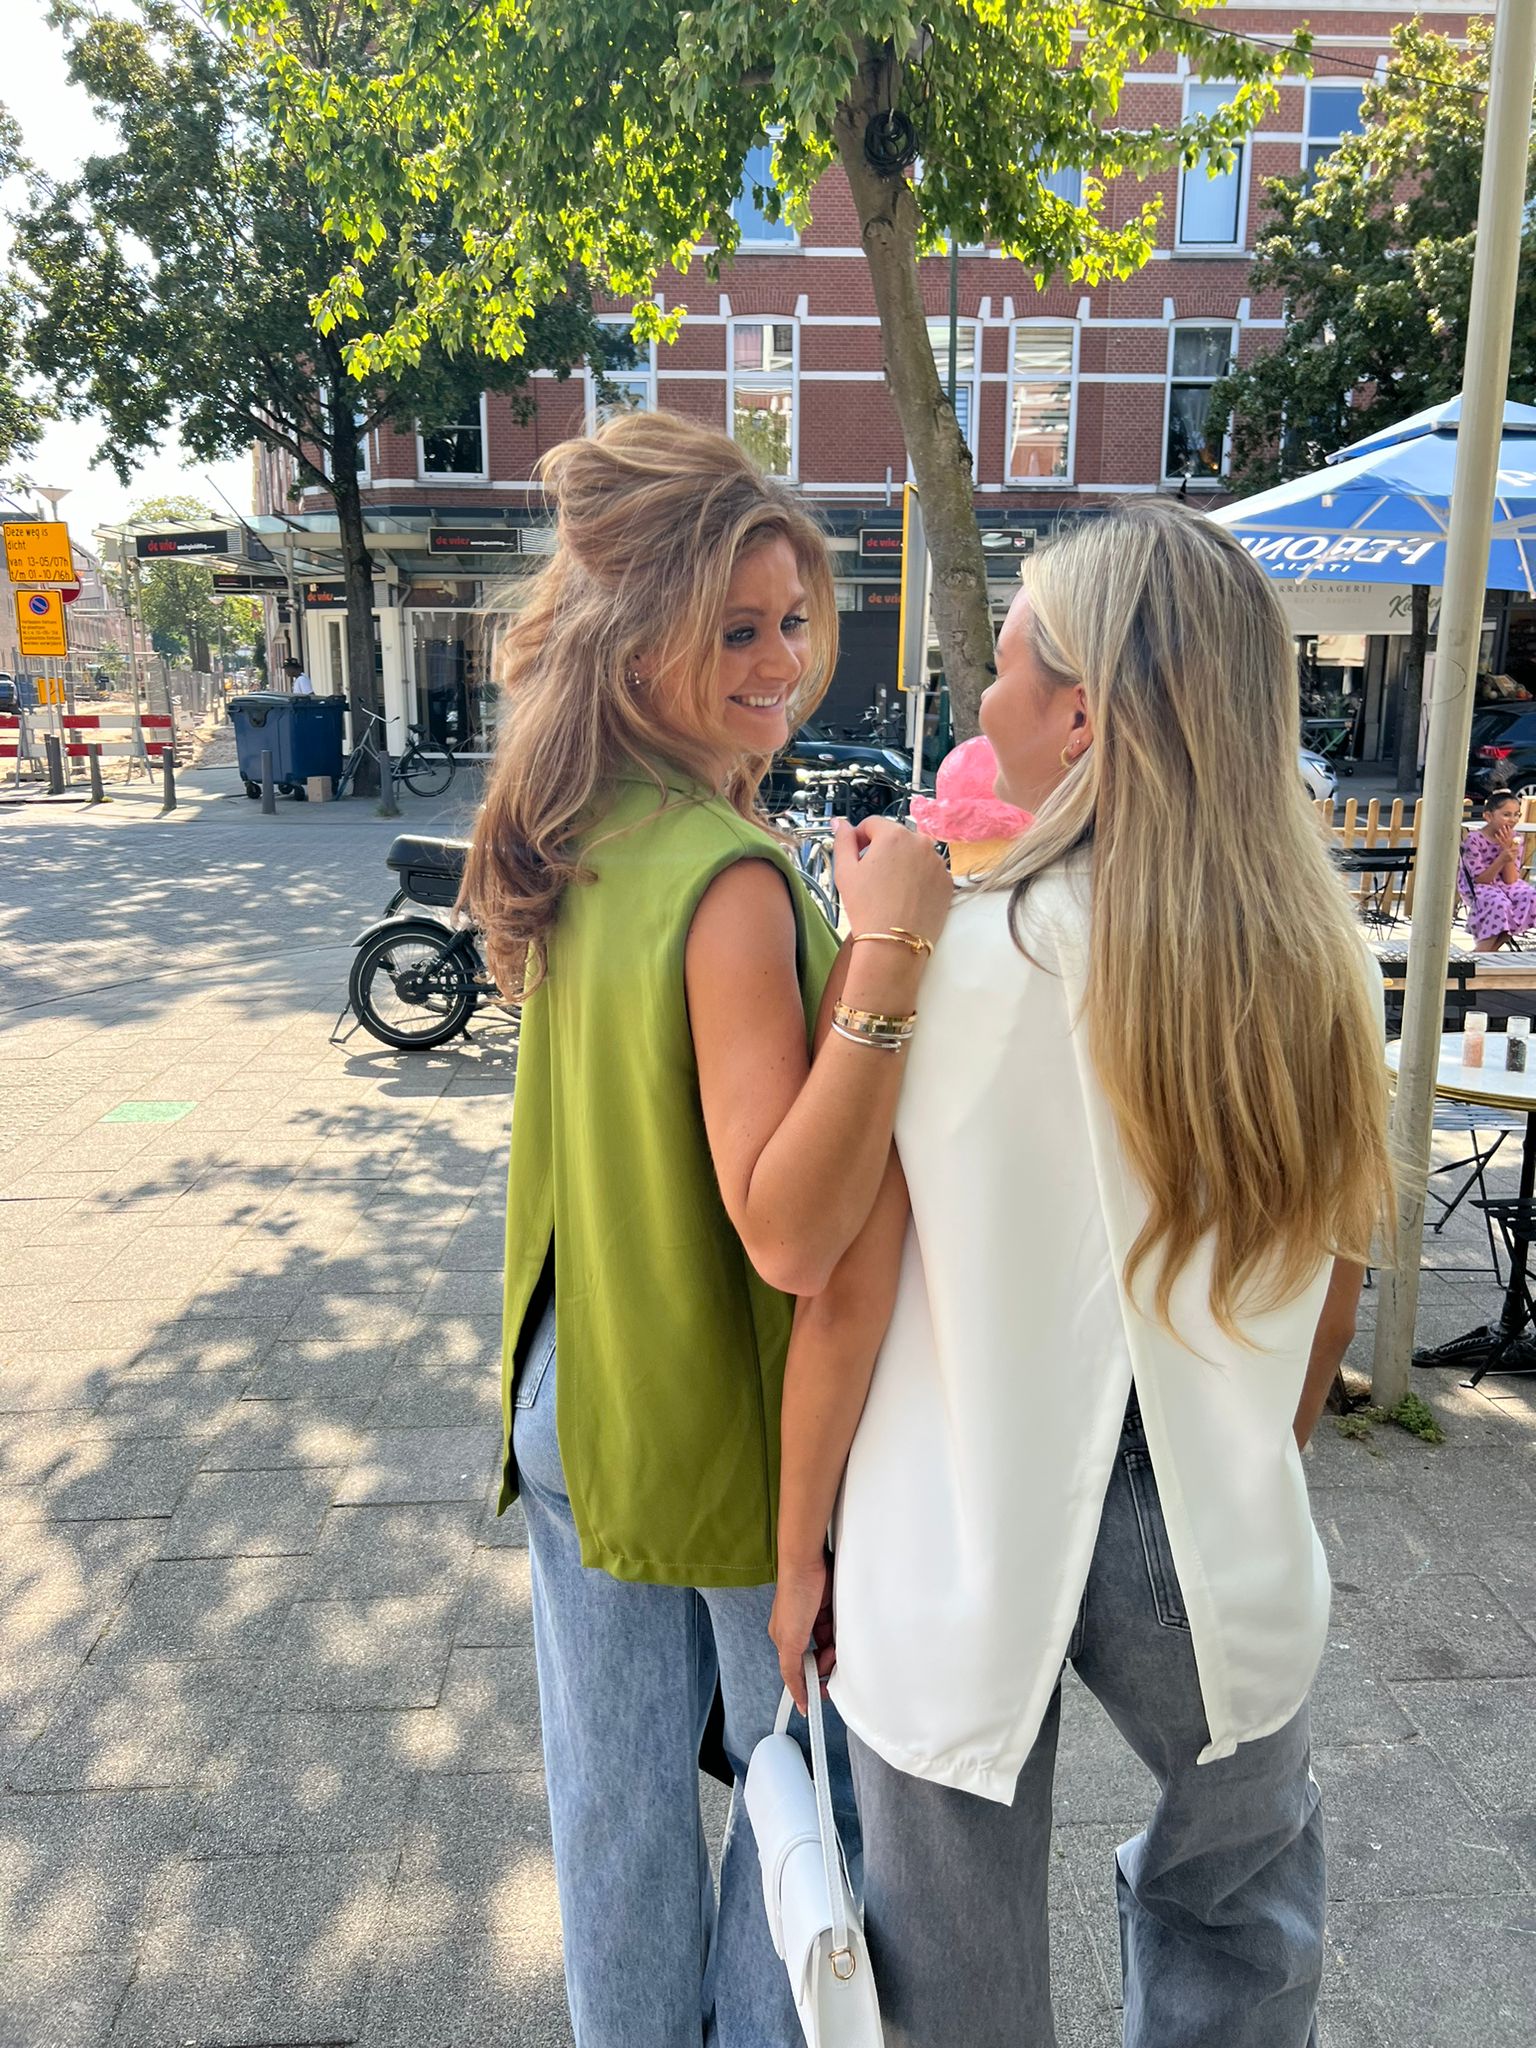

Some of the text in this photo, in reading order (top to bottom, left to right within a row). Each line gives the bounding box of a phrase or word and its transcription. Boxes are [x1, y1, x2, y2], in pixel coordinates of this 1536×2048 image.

[5, 527, 49, 540] Deze weg is
[7, 540, 26, 550] dicht
[147, 539, 158, 552] de
[435, 535, 448, 545] de
[865, 537, 878, 547] de
[10, 556, 69, 567] van 13-05/07h
[11, 569, 26, 580] t/m
[1278, 583, 1373, 594] RRELSLAGERIJ
[867, 592, 902, 604] de vri
